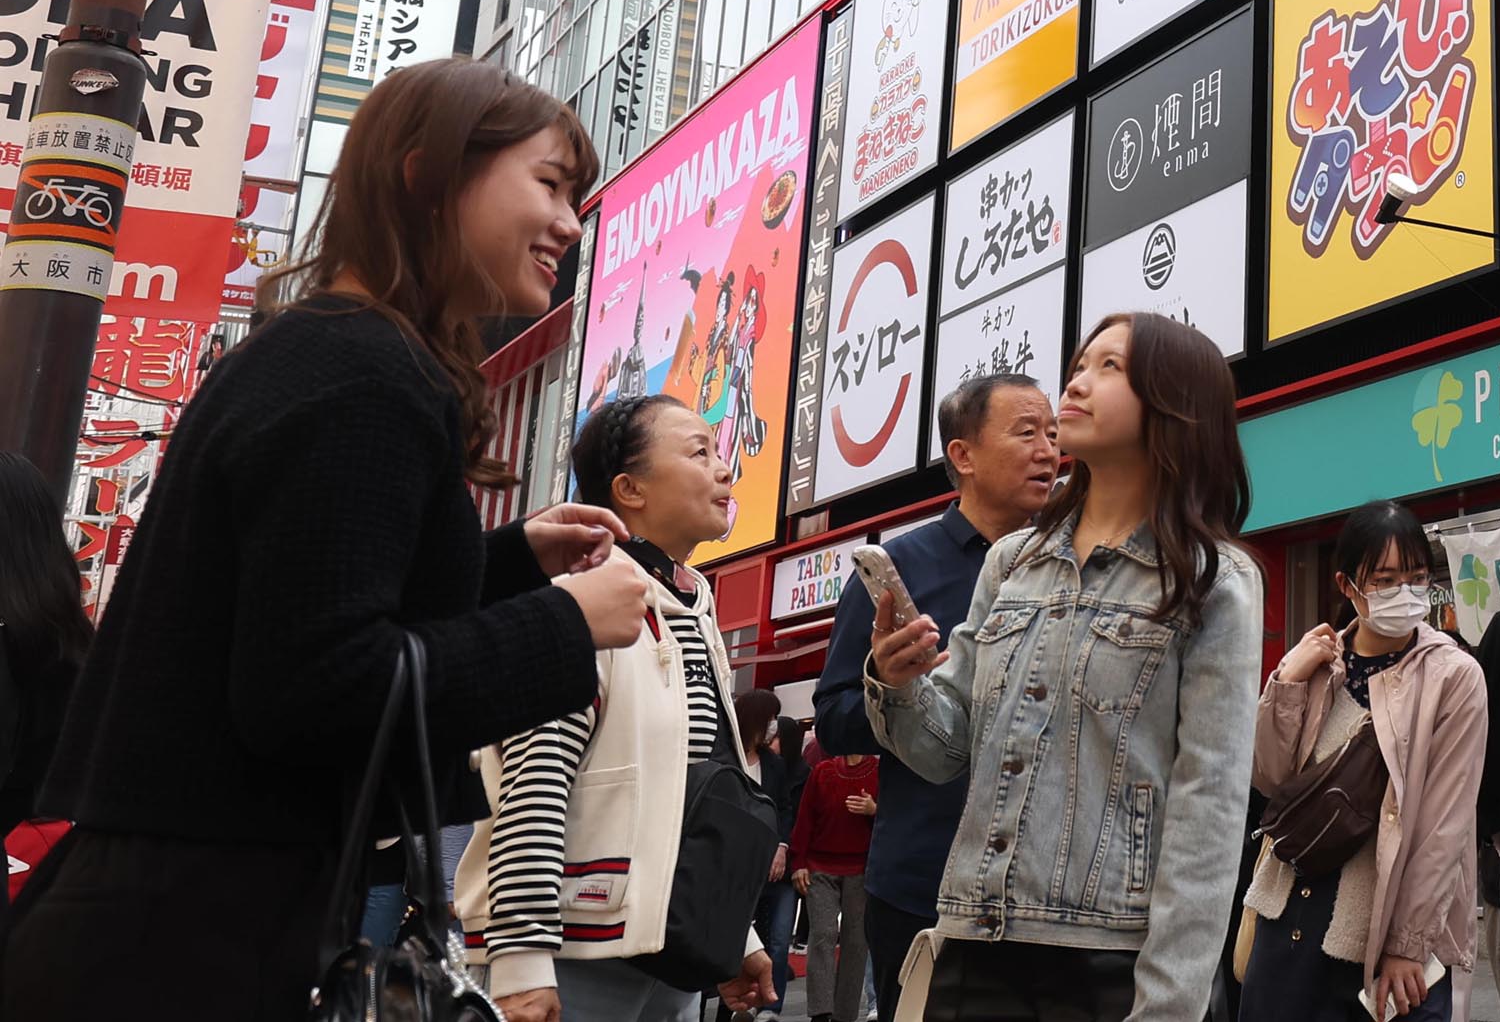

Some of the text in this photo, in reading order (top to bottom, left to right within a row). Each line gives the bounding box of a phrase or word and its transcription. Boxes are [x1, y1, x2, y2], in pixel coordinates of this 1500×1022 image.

[353, 14, 374, 73] THEATER
[879, 53, 916, 90] KARAOKE
[879, 77, 914, 114] カラオケ
[853, 95, 927, 182] まねきねこ
[859, 149, 917, 200] MANEKINEKO
[1163, 141, 1210, 177] enma
[980, 167, 1033, 221] 串カツ
[955, 195, 1056, 291] しろたや
[9, 259, 104, 285] 大阪市
[981, 305, 1015, 338] 牛カツ
[826, 318, 922, 401] スシロー
[797, 550, 841, 582] TARO's
[790, 576, 842, 611] PARLOR
